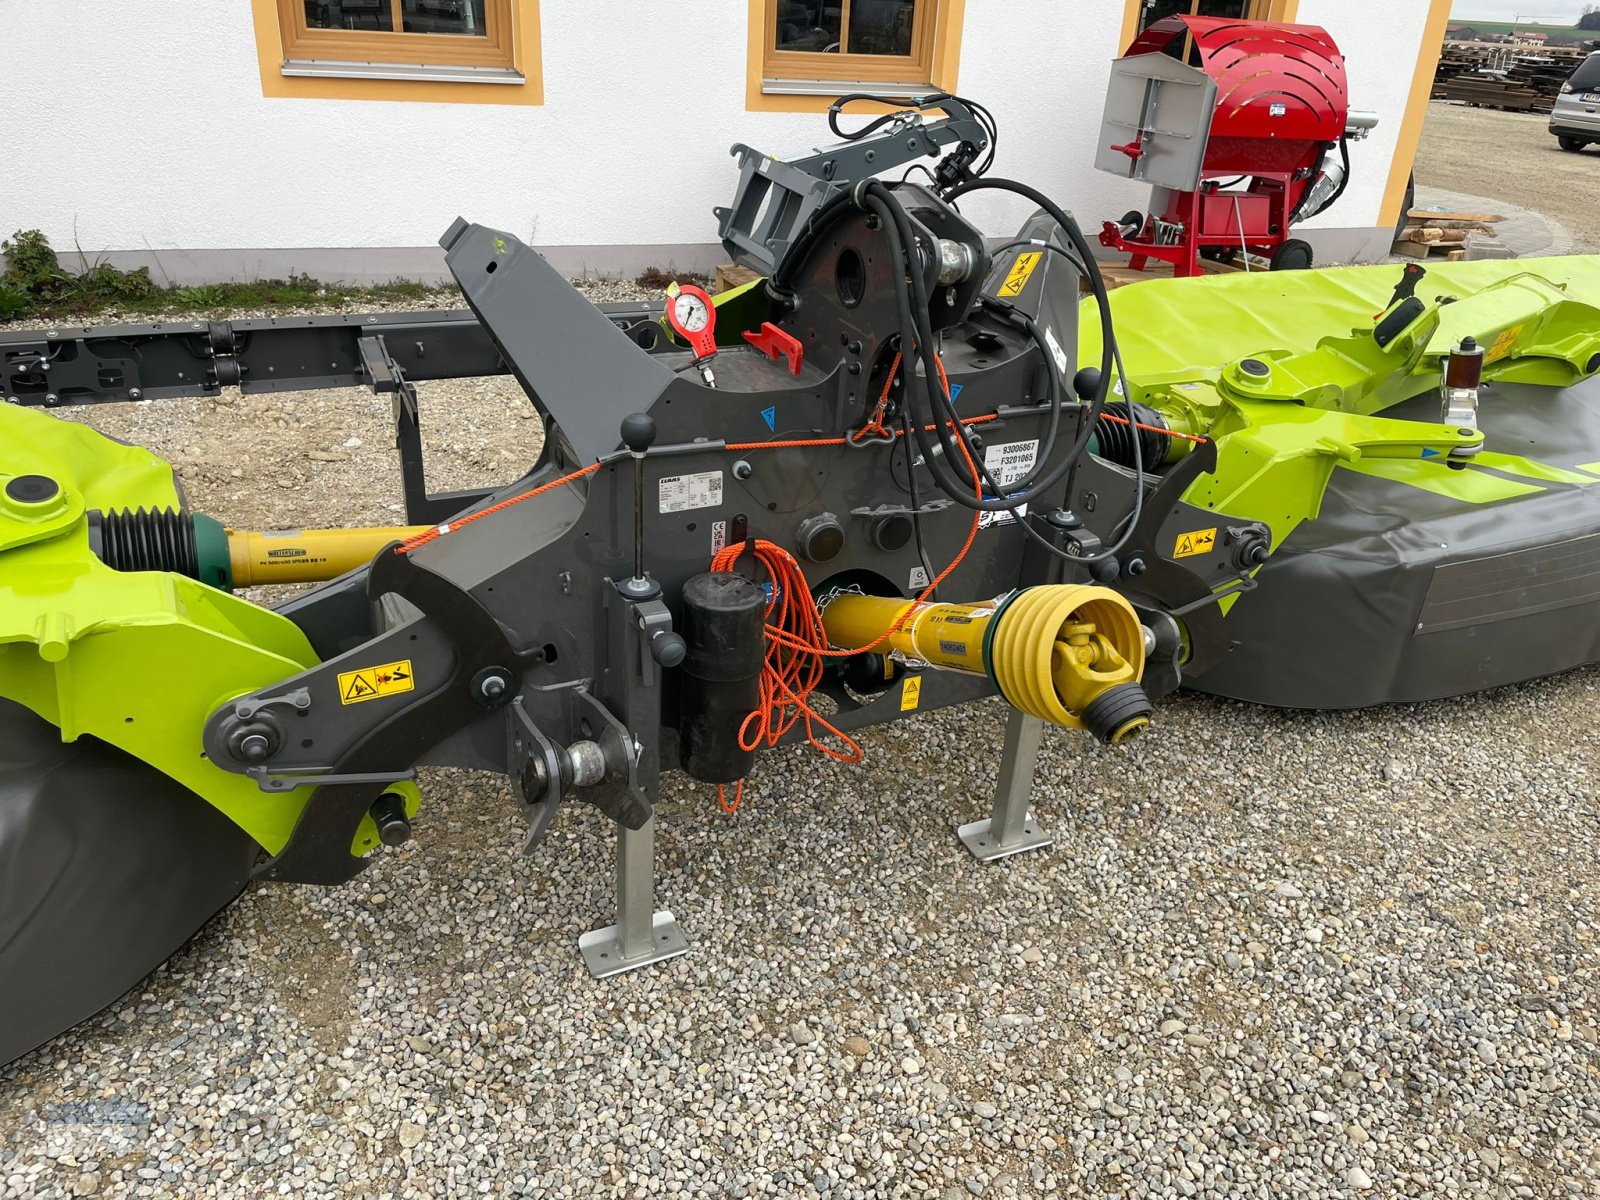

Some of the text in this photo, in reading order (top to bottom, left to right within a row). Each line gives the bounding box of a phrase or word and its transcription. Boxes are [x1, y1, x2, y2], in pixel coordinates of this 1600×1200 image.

[1003, 443, 1035, 454] 93006867
[1001, 454, 1033, 465] F3201065
[1005, 474, 1013, 482] TJ
